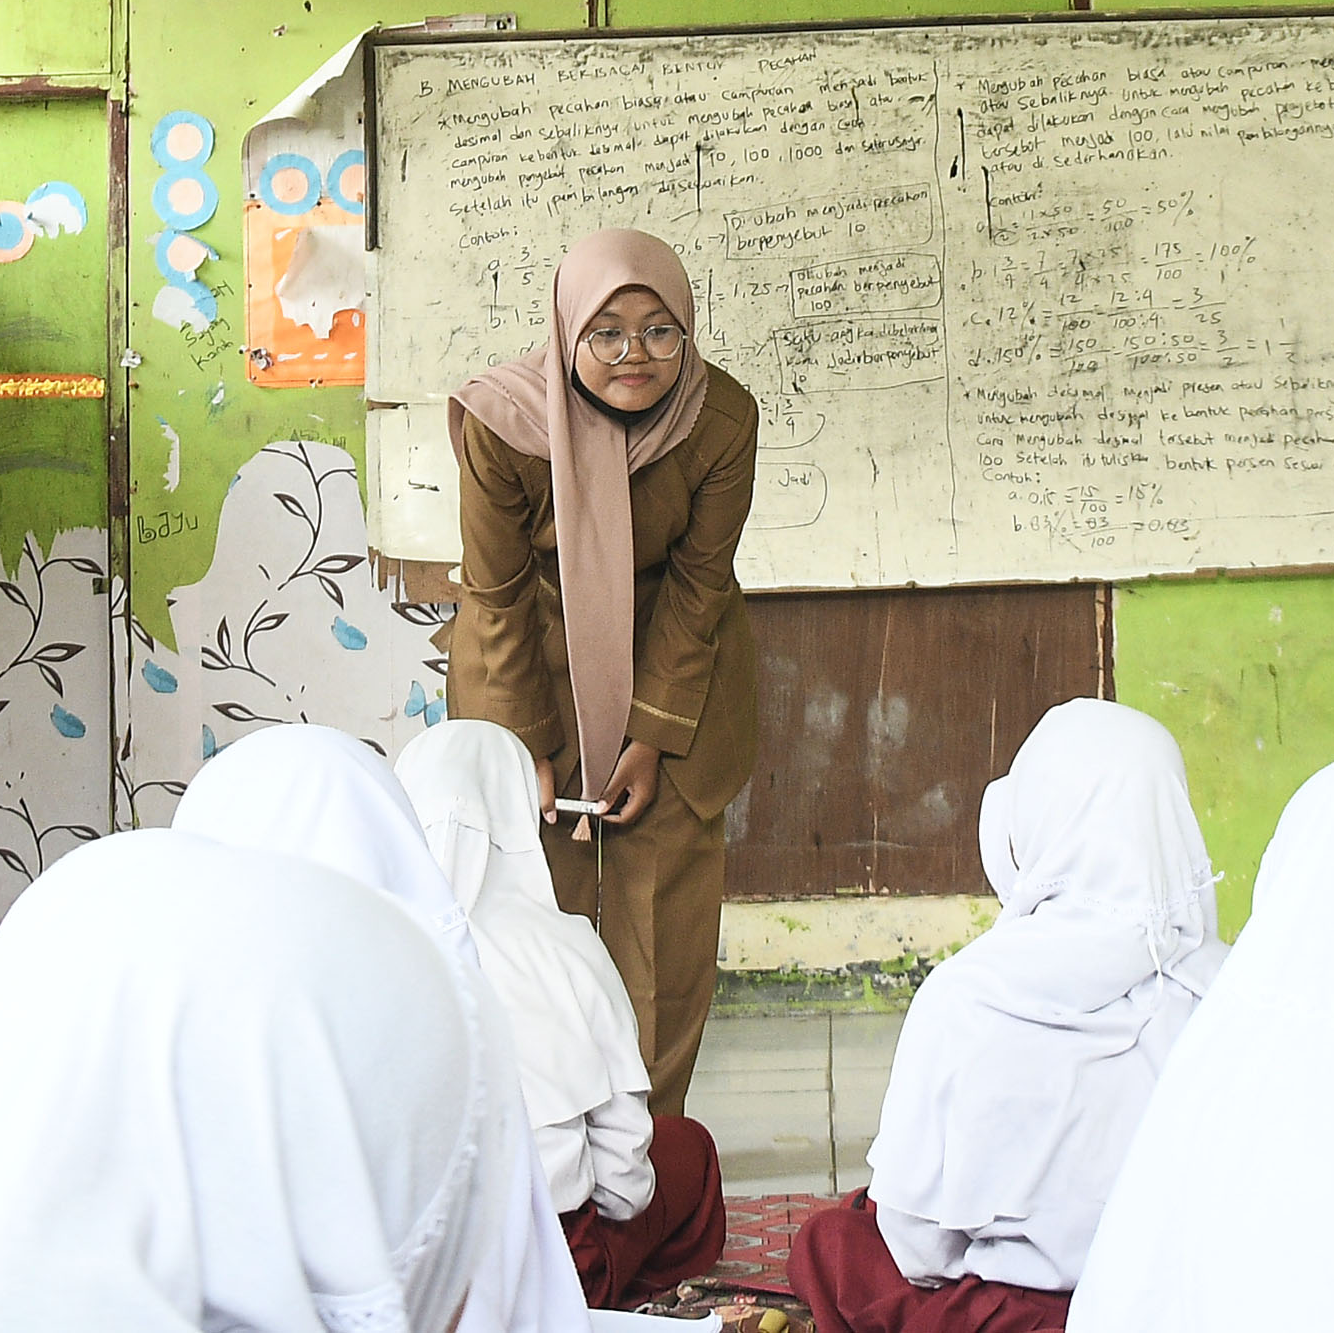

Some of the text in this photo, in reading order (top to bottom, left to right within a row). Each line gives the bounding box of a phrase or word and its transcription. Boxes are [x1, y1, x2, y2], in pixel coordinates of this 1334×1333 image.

[445, 73, 536, 97] MENGUBAH
[757, 49, 818, 73] PECAHAN
[978, 76, 1044, 95] Mengubah
[1052, 69, 1107, 90] pecahan
[1126, 67, 1167, 83] biasa
[1180, 68, 1210, 79] atau
[548, 97, 611, 121] pecahan
[673, 89, 707, 105] atau
[720, 81, 795, 103] campuran
[819, 72, 877, 94] menjadi
[889, 71, 929, 87] bentuk
[979, 97, 1009, 114] atau
[1169, 82, 1229, 101] mengubah
[1240, 81, 1296, 101] pecahan
[454, 129, 503, 150] desimal
[509, 125, 533, 141] dan
[687, 110, 754, 127] mengubah
[762, 101, 814, 119] pecahan
[976, 116, 1015, 141] dapat
[1027, 112, 1095, 133] dilakukan
[1108, 105, 1157, 126] dengan
[1202, 102, 1260, 122] mengubah
[450, 152, 509, 170] campuran
[779, 119, 826, 136] dengan
[981, 137, 1046, 160] tersebut
[449, 170, 507, 191] mengubah
[578, 163, 626, 183] pecahan
[806, 202, 868, 220] menjadi
[736, 222, 867, 251] berpenyebut 10
[1154, 242, 1182, 256] 175
[858, 257, 906, 277] menjadi
[1155, 267, 1182, 281] 100
[809, 299, 833, 313] 100
[1231, 376, 1264, 392] atau
[1158, 429, 1215, 447] tersebut
[979, 453, 1004, 467] 100
[1166, 454, 1218, 472] bentuk
[1079, 500, 1109, 515] 100
[1089, 534, 1116, 549] 100
